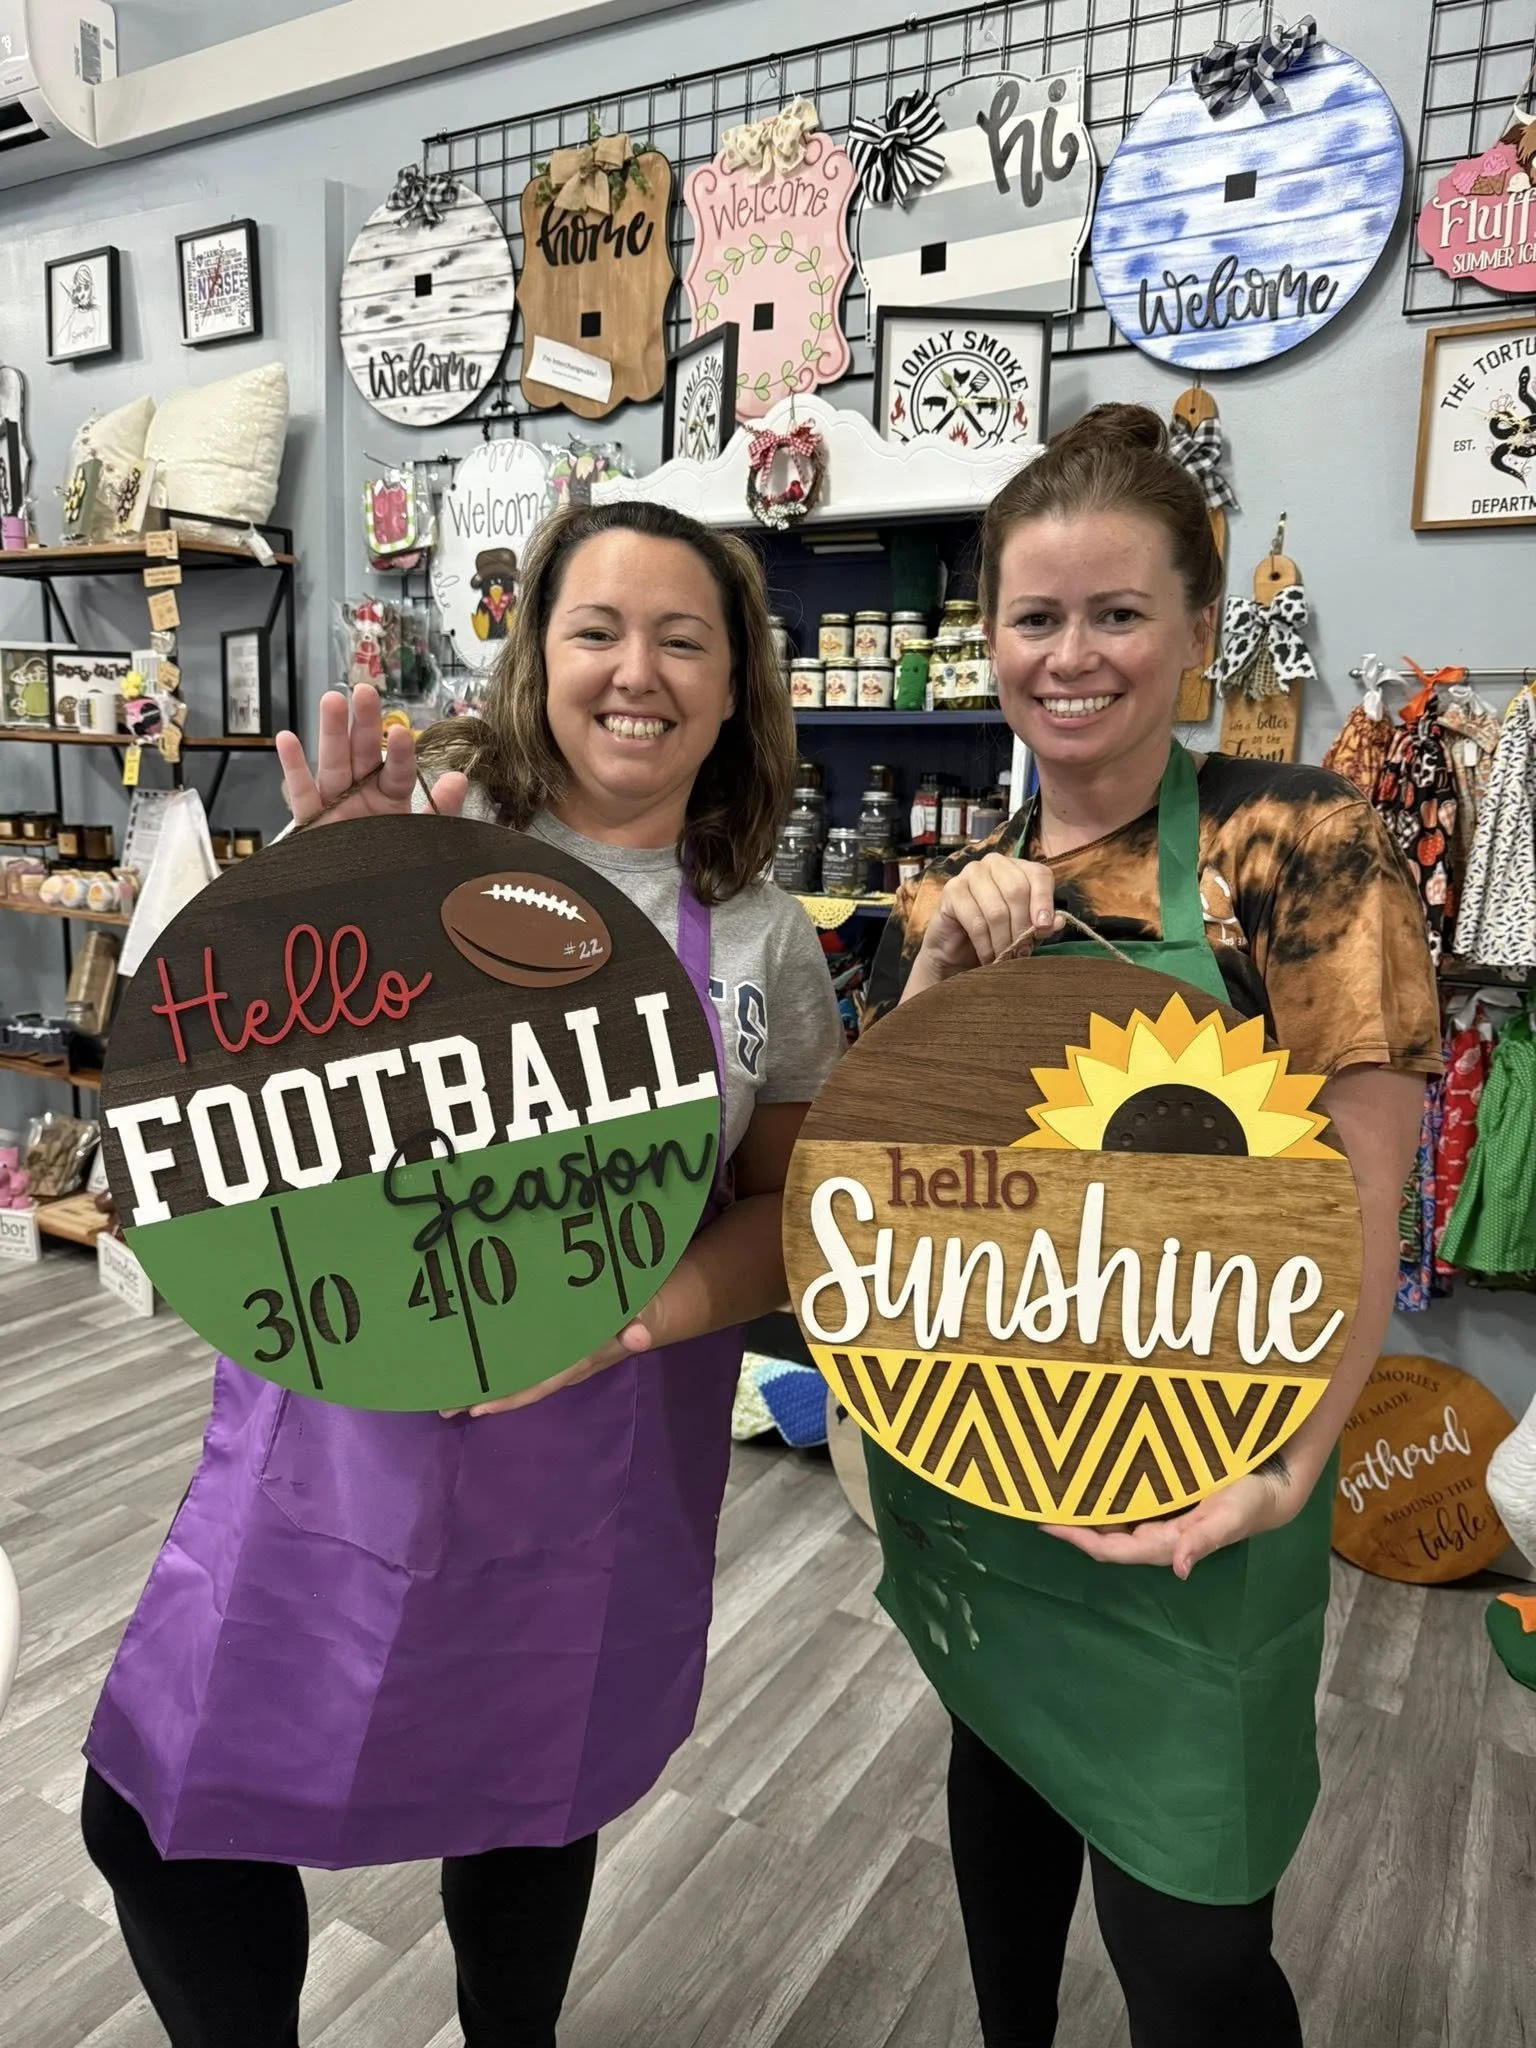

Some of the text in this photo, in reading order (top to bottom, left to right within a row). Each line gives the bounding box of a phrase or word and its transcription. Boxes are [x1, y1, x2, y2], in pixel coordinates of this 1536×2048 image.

[976, 79, 1080, 208] hi
[536, 199, 654, 266] home
[710, 177, 829, 240] Welcome
[1432, 188, 1536, 248] Fluff
[1453, 243, 1536, 274] SUMMER IC
[1139, 255, 1340, 335] Welcome
[369, 342, 482, 398] Welcome
[682, 360, 702, 411] ONLY
[704, 356, 724, 391] SMO
[894, 330, 1029, 394] I ONLY SMOKE
[1440, 336, 1536, 410] THE TORTU
[1453, 439, 1477, 452] EST.
[563, 938, 603, 960] #22
[152, 924, 432, 1064] Hello
[105, 992, 719, 1227] FOOTBALL
[383, 1129, 714, 1252] Season
[886, 1148, 1038, 1209] hello
[800, 1176, 1345, 1366] Sunshine
[1344, 1390, 1413, 1432] ARE MADE
[1366, 1370, 1441, 1393] EMORIES
[1339, 1405, 1471, 1514] gathered
[1382, 1475, 1477, 1528] AROUND THE
[1410, 1502, 1487, 1561] table
